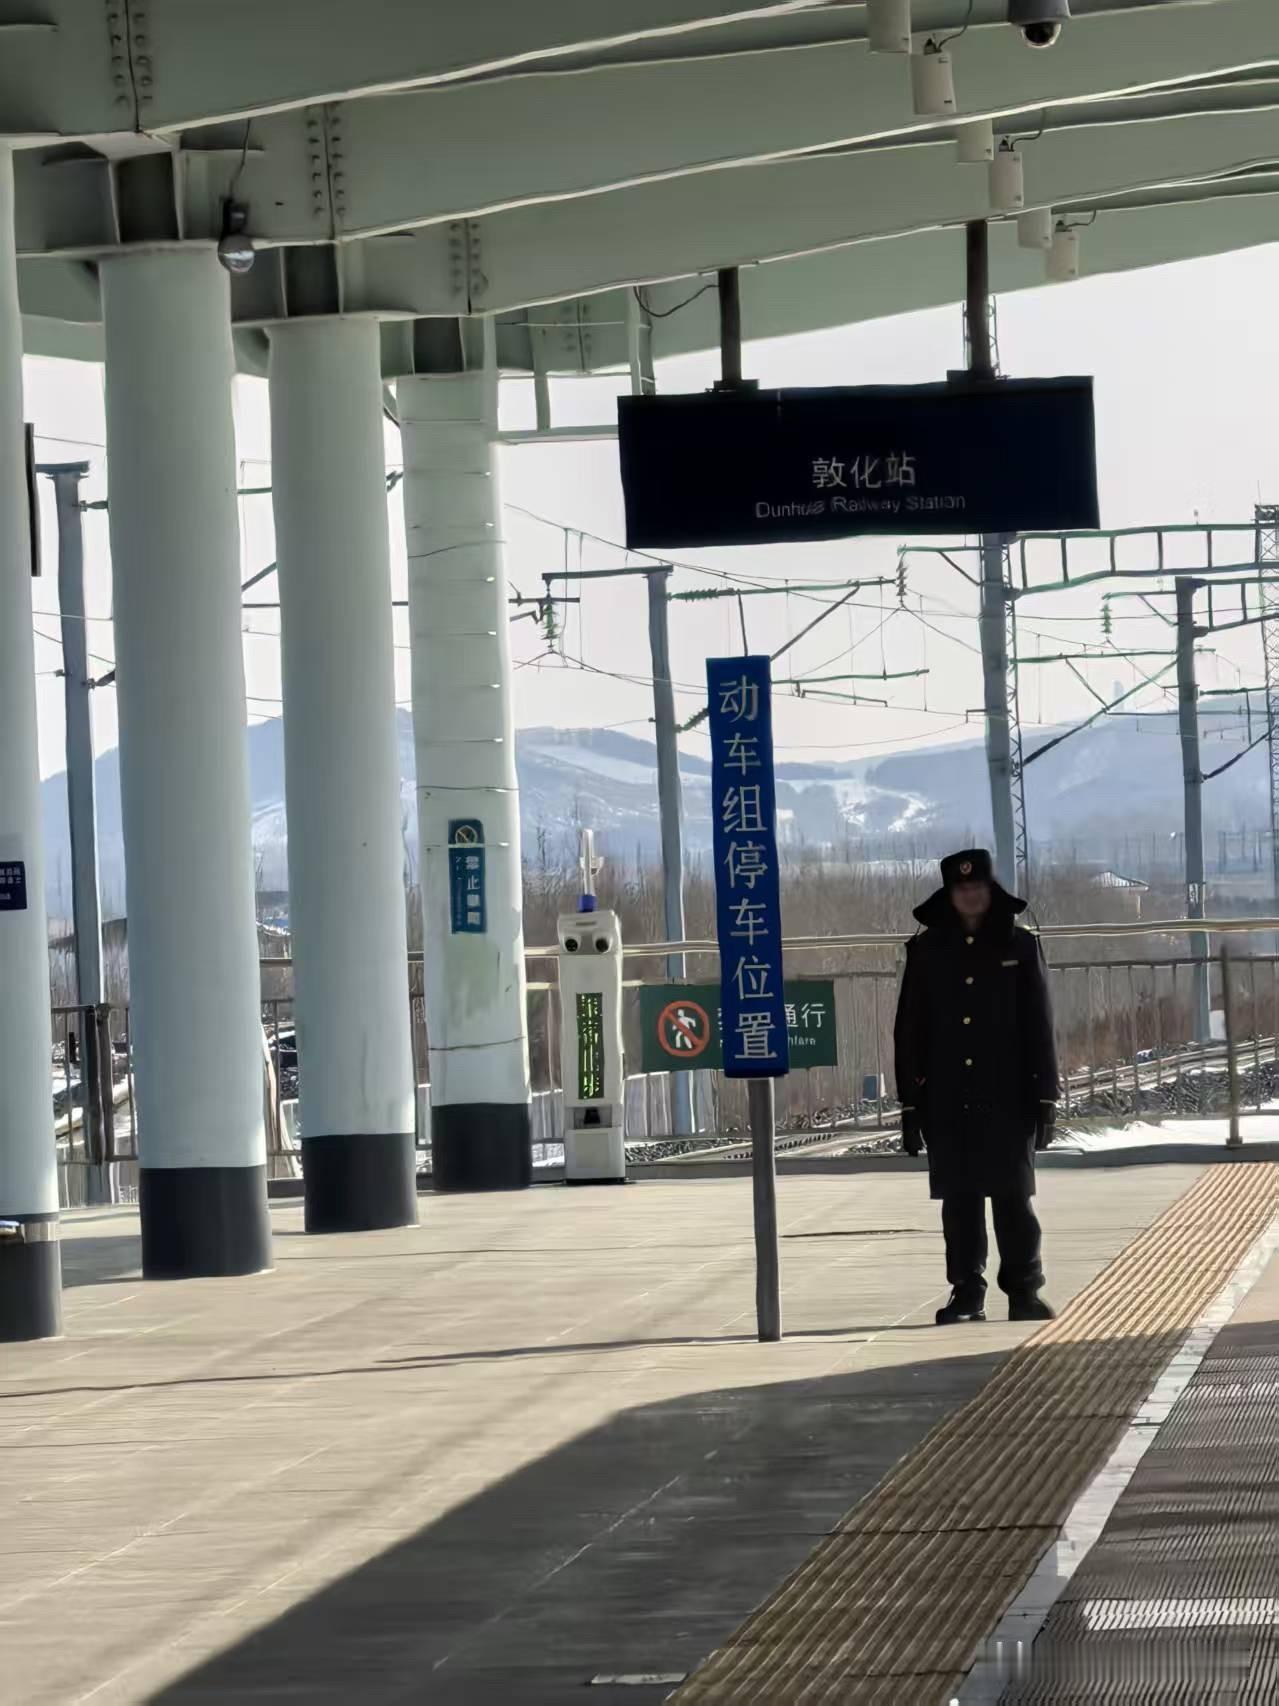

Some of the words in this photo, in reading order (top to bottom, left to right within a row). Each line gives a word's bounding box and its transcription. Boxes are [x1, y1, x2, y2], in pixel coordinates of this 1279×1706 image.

[811, 451, 917, 489] 敦化站
[755, 500, 824, 518] Dunhua
[831, 496, 901, 513] Railway
[906, 495, 965, 511] Station
[718, 675, 777, 1060] 动车组停车位置
